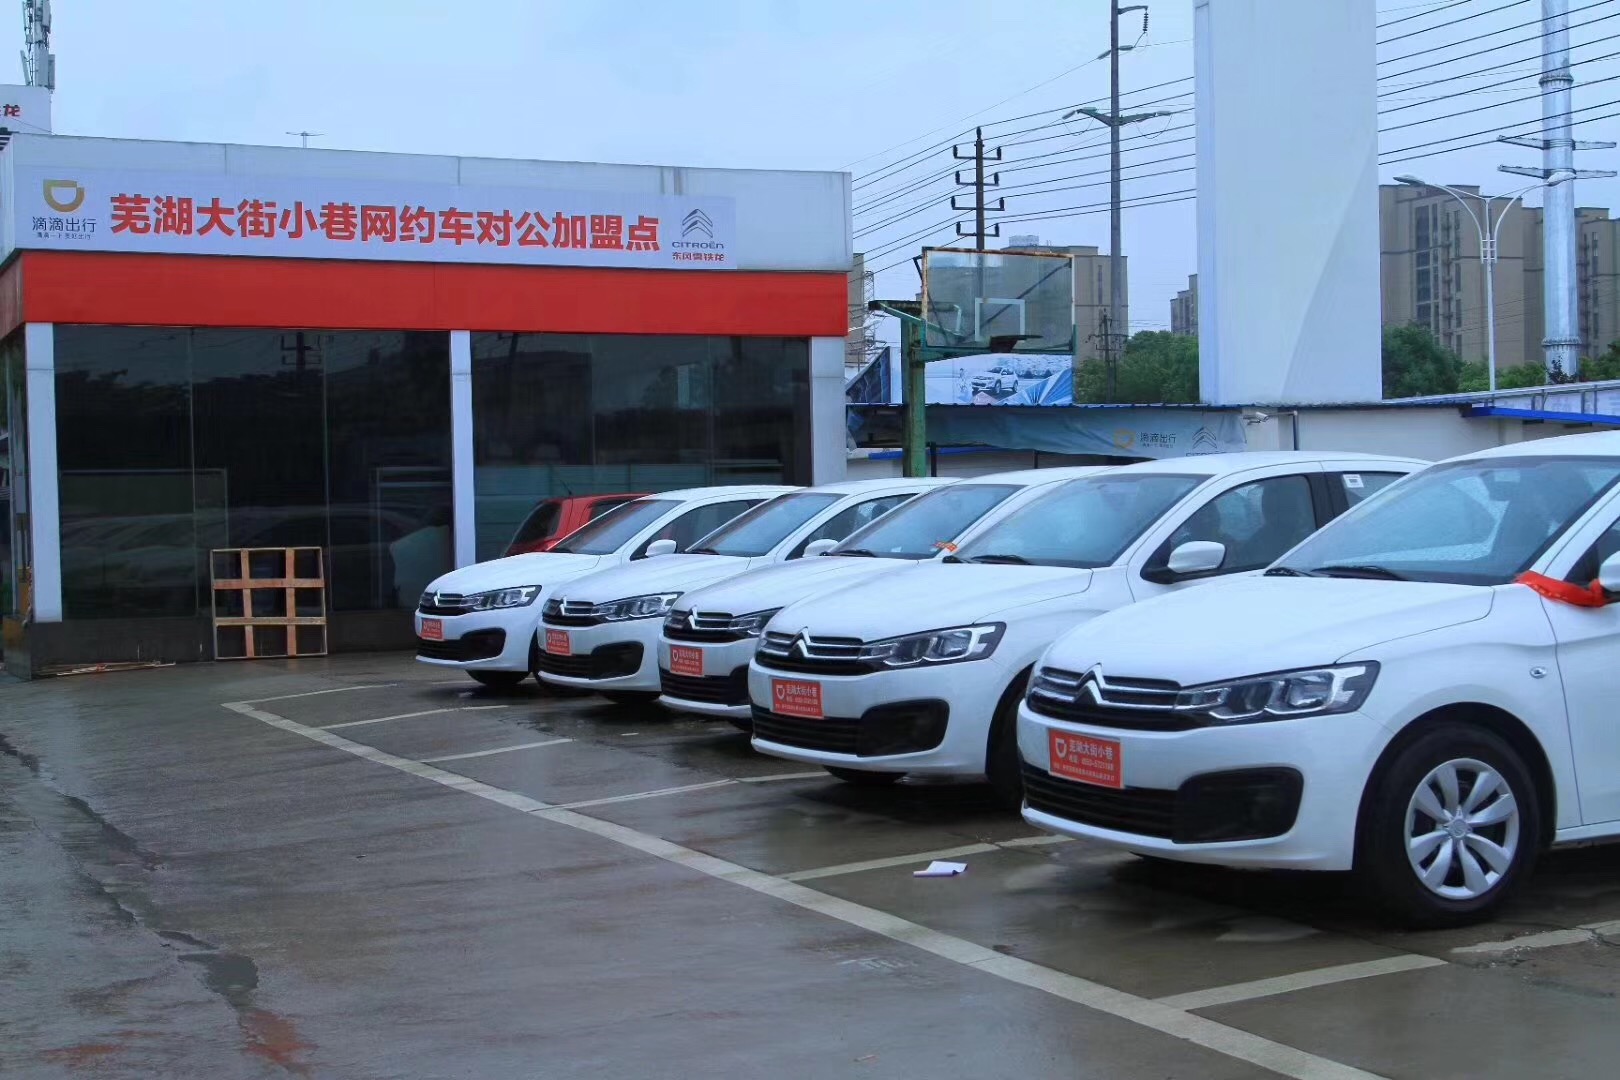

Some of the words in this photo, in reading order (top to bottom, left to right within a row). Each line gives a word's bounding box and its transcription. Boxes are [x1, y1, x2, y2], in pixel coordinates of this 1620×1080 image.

[0, 104, 21, 117] 龙
[32, 216, 96, 233] 滴滴出行
[110, 193, 660, 251] 芜湖大街小巷网约车对公加盟点
[672, 251, 725, 262] 东风雪铁龙
[1069, 739, 1113, 760] 芜湖大街小巷
